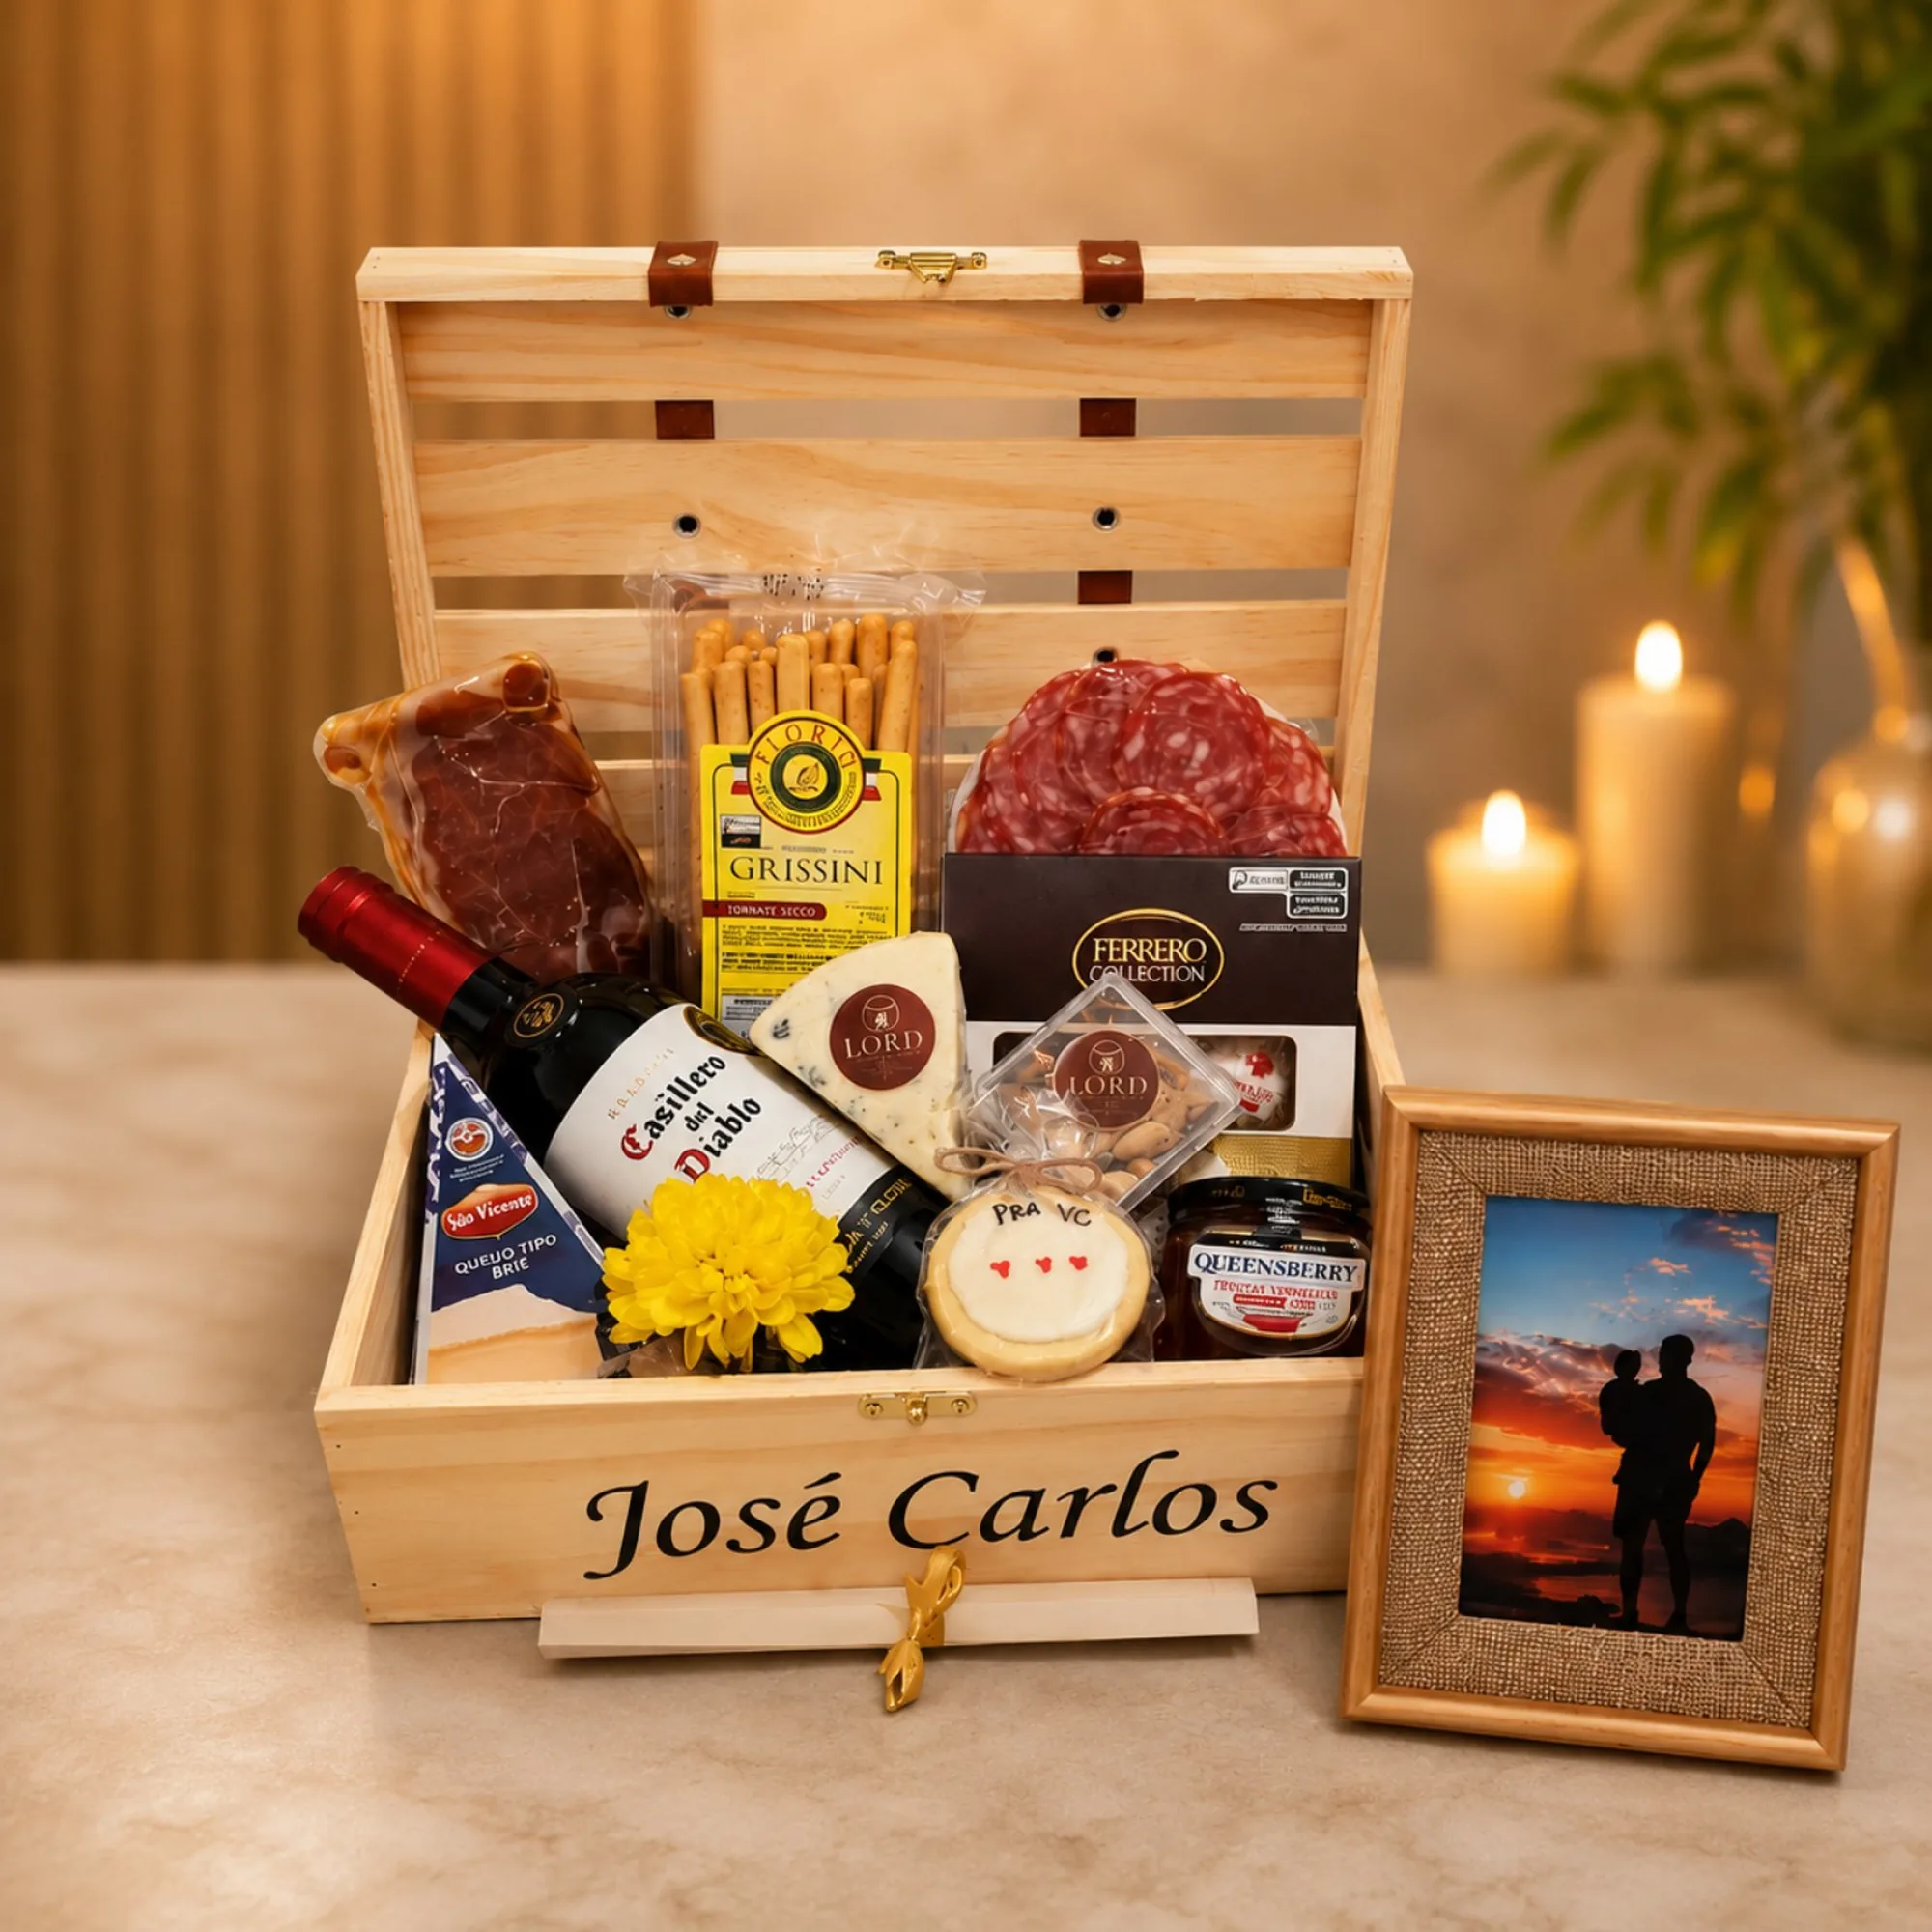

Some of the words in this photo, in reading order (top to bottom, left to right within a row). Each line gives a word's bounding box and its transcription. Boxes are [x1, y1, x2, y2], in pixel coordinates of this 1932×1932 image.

[729, 856, 883, 885] GRISSINI
[1093, 938, 1207, 963] FERRERO
[844, 1030, 923, 1059] LORD
[1069, 1075, 1148, 1095] LORD
[620, 1055, 726, 1160] Casillero
[674, 1097, 762, 1183] Diablo
[475, 1194, 533, 1220] Vicente
[992, 1202, 1041, 1226] PRA
[1057, 1203, 1092, 1227] VC
[518, 1235, 557, 1255] TIPO
[492, 1257, 529, 1280] BRIE
[1194, 1252, 1358, 1283] QUEENSBERRY
[583, 1471, 843, 1581] José
[888, 1449, 1279, 1552] Carlos
